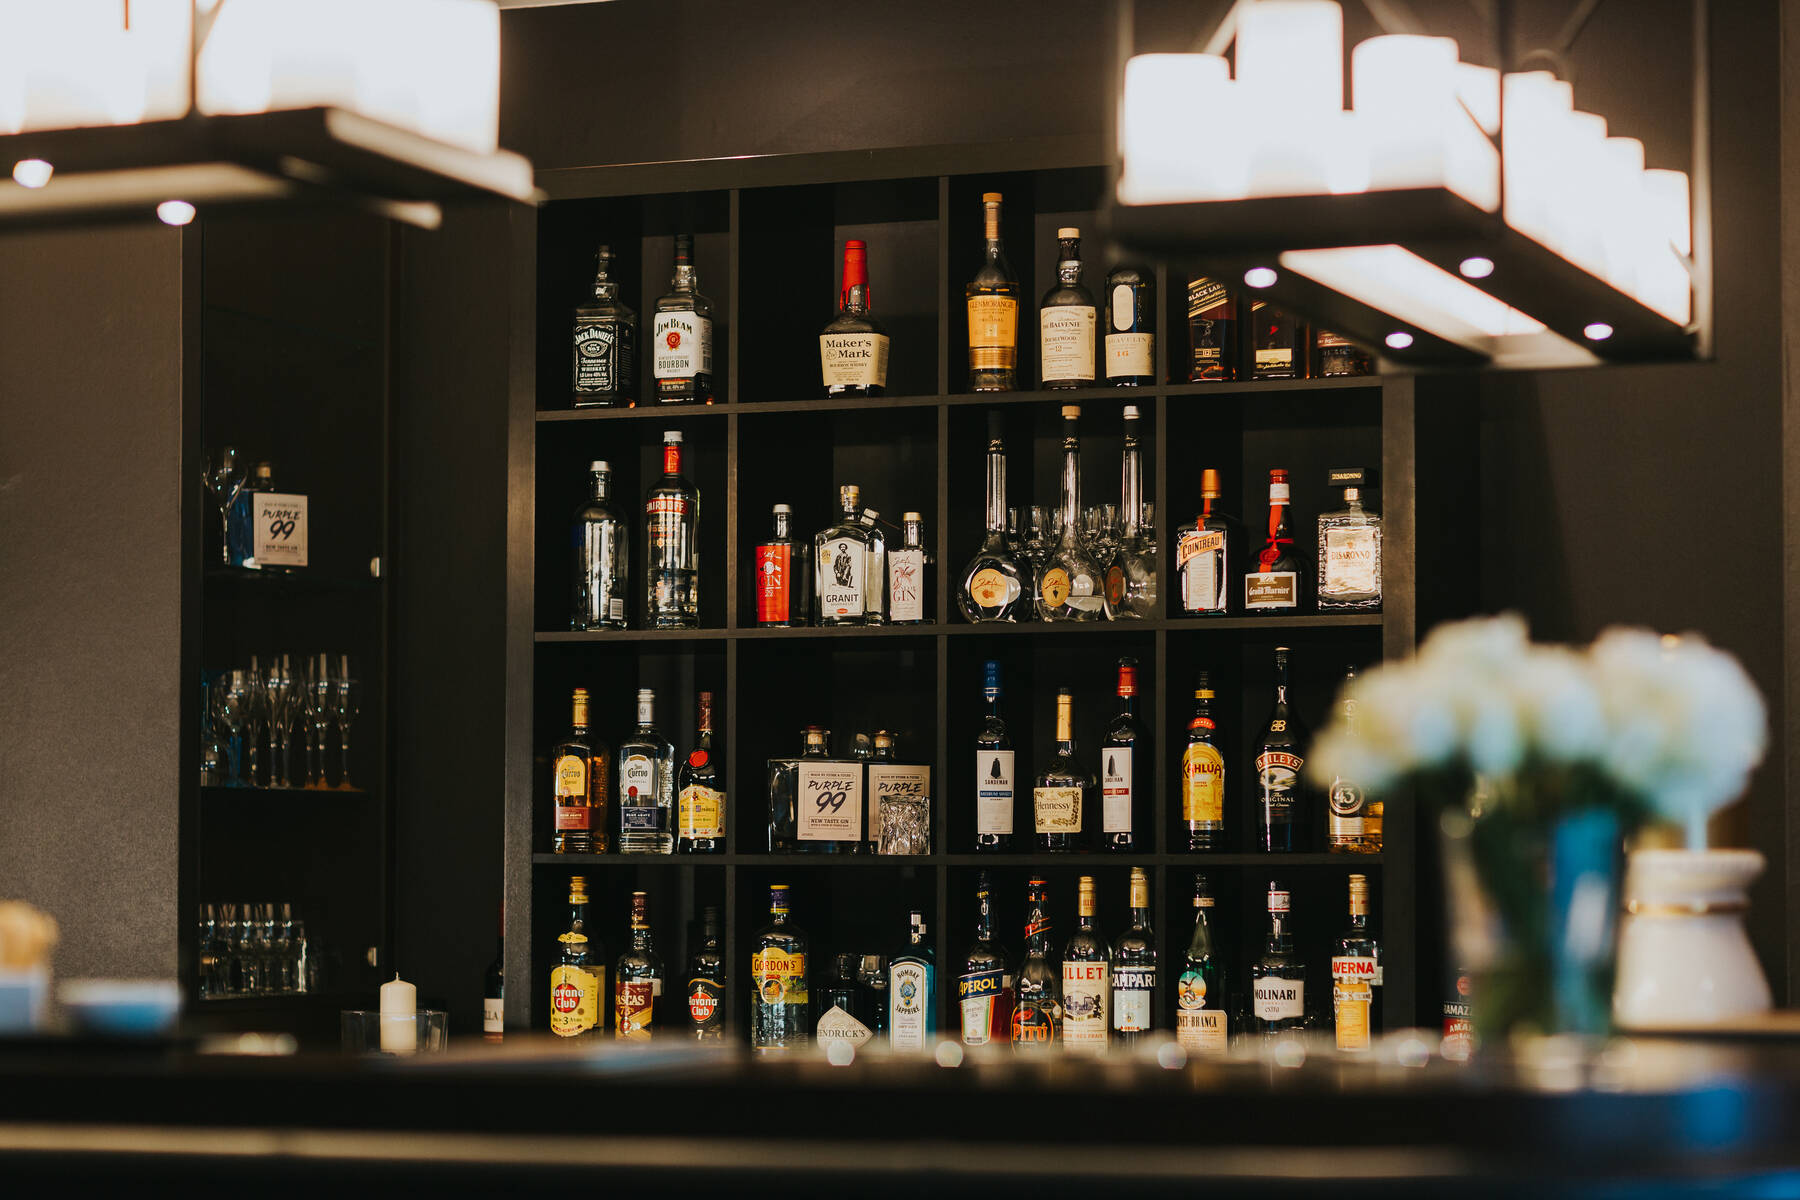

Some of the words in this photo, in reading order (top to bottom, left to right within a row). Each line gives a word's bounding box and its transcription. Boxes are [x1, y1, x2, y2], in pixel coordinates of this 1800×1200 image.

[1188, 289, 1208, 301] BLACK
[1208, 284, 1224, 295] LAB
[656, 322, 669, 337] JIM
[670, 318, 692, 334] BEAM
[575, 331, 590, 345] JACK
[826, 340, 872, 348] Maker's
[838, 350, 872, 358] Mark
[658, 360, 690, 369] BOURBON
[1331, 472, 1362, 480] DISARONNO
[262, 509, 300, 520] PURPLE
[270, 520, 295, 540] 99
[1182, 534, 1220, 558] COINTREAU
[1332, 550, 1370, 560] DISARONNO
[760, 574, 782, 587] GIN
[826, 594, 859, 602] GRANIT
[893, 590, 916, 602] GIN
[1257, 754, 1300, 768] BAILEYS
[628, 768, 648, 778] Cuervo
[1182, 760, 1222, 779] KAHLÚA
[808, 780, 854, 791] PURPLE
[878, 782, 922, 792] PURPLE
[1334, 788, 1355, 804] 43
[816, 792, 847, 814] 99
[1038, 802, 1071, 811] Hennessy
[754, 958, 796, 971] GORDON'S
[896, 969, 920, 980] BOMBAY
[1063, 967, 1104, 980] ILLET
[960, 978, 997, 996] APEROL
[556, 998, 576, 1008] Club
[616, 995, 645, 1006] ASCAS
[692, 1006, 709, 1016] Club
[895, 1004, 920, 1014] SAPPHIRE
[564, 1016, 568, 1025] 3
[696, 1030, 703, 1040] 7
[818, 1030, 866, 1038] ENDRICK'S
[1013, 1022, 1048, 1041] PITÚ
